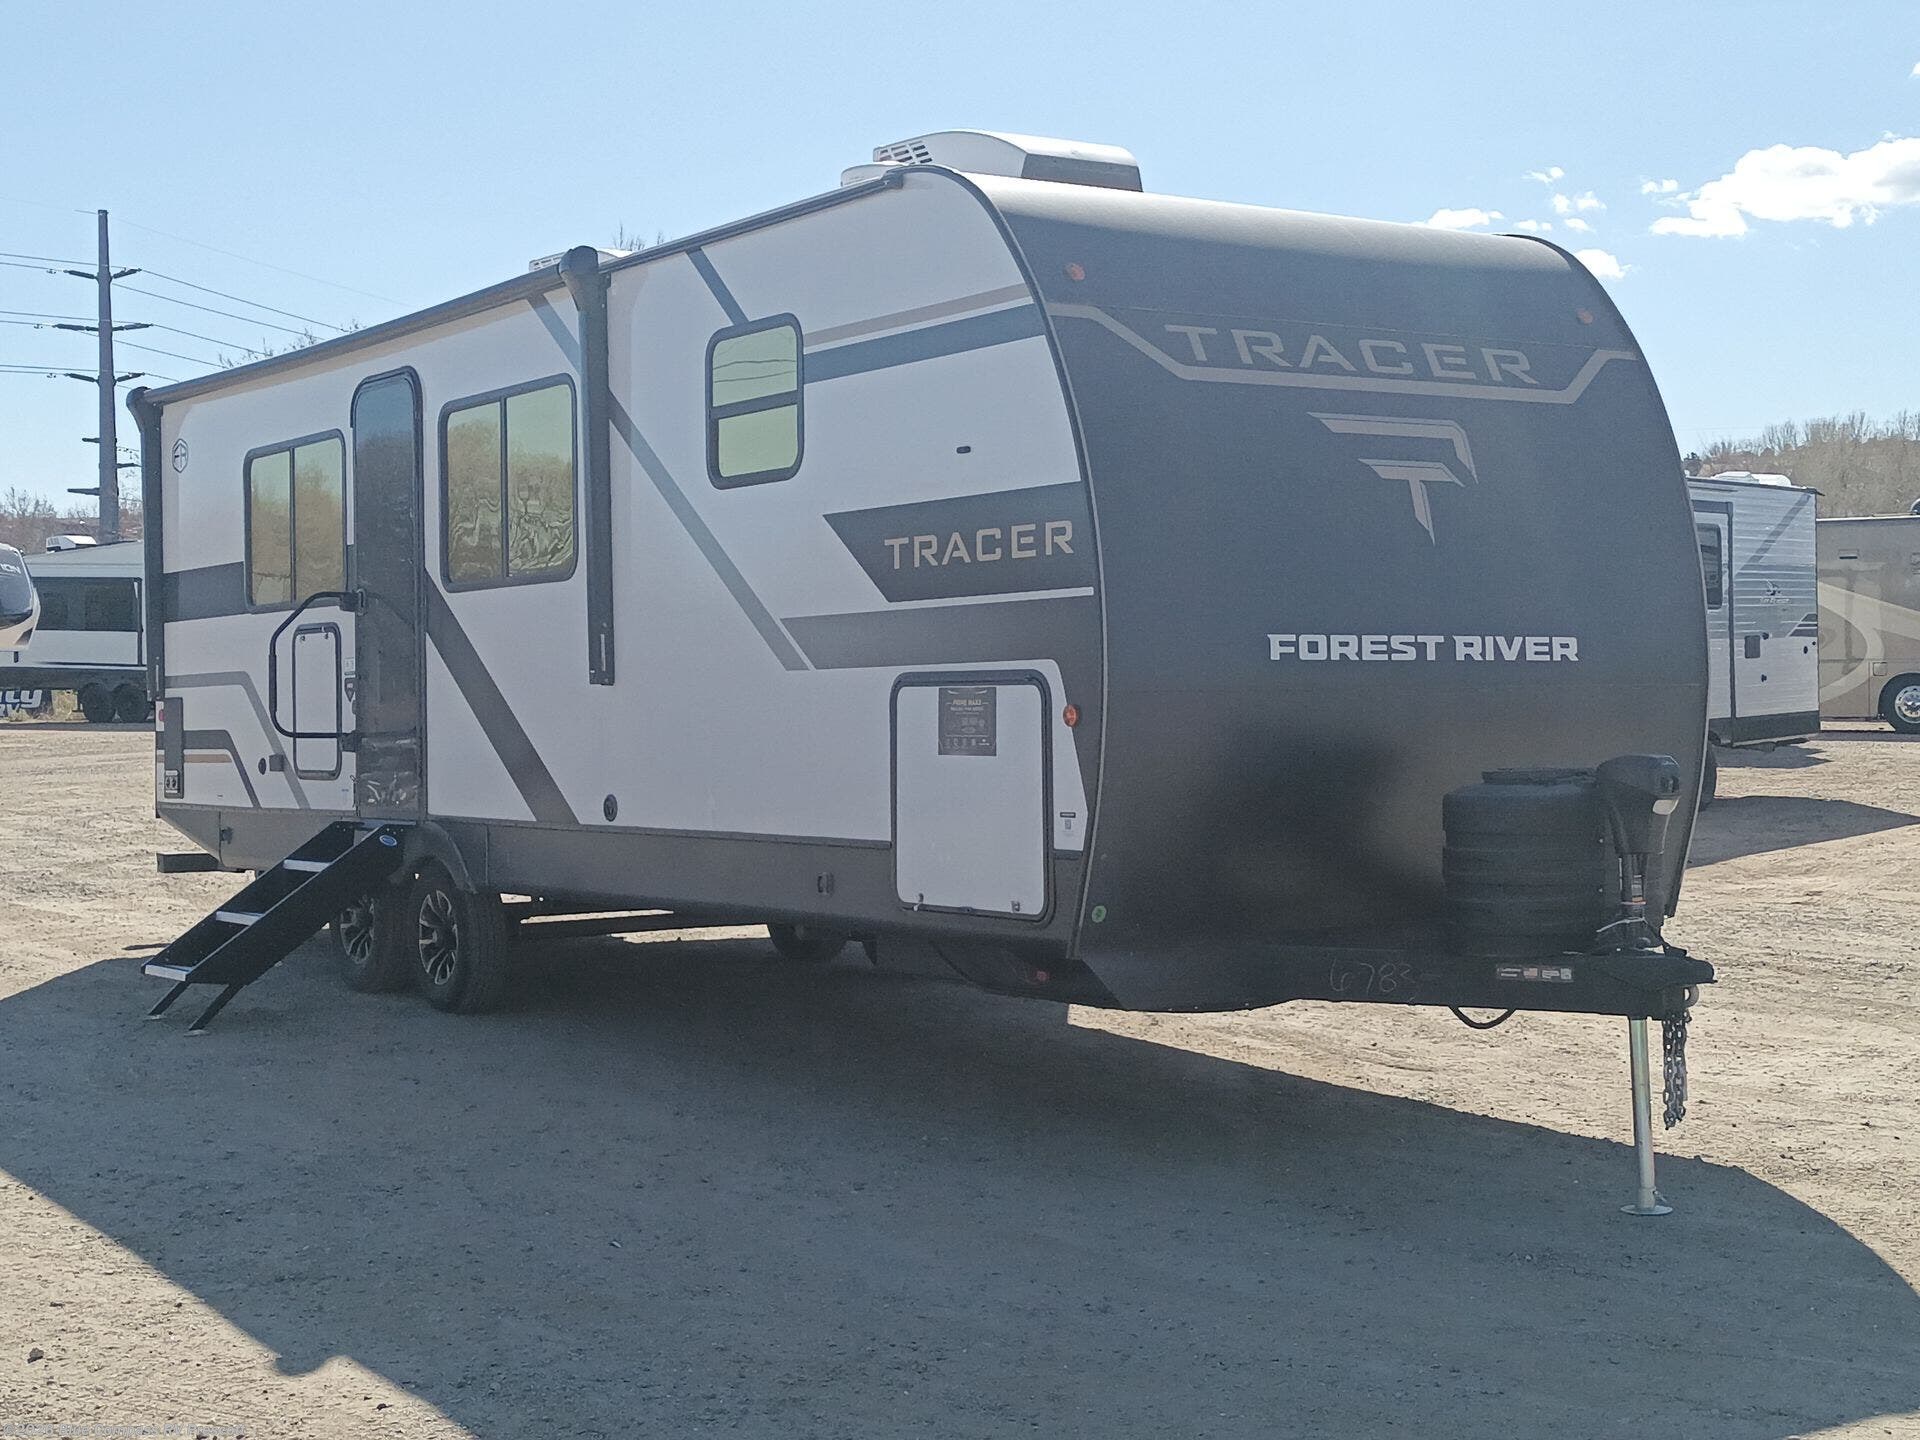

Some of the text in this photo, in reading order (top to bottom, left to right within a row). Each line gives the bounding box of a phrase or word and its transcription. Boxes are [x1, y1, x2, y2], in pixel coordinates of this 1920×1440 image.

[1164, 324, 1539, 385] TRACER
[884, 519, 1074, 570] TRACER
[1267, 634, 1579, 662] FOREST RIVER
